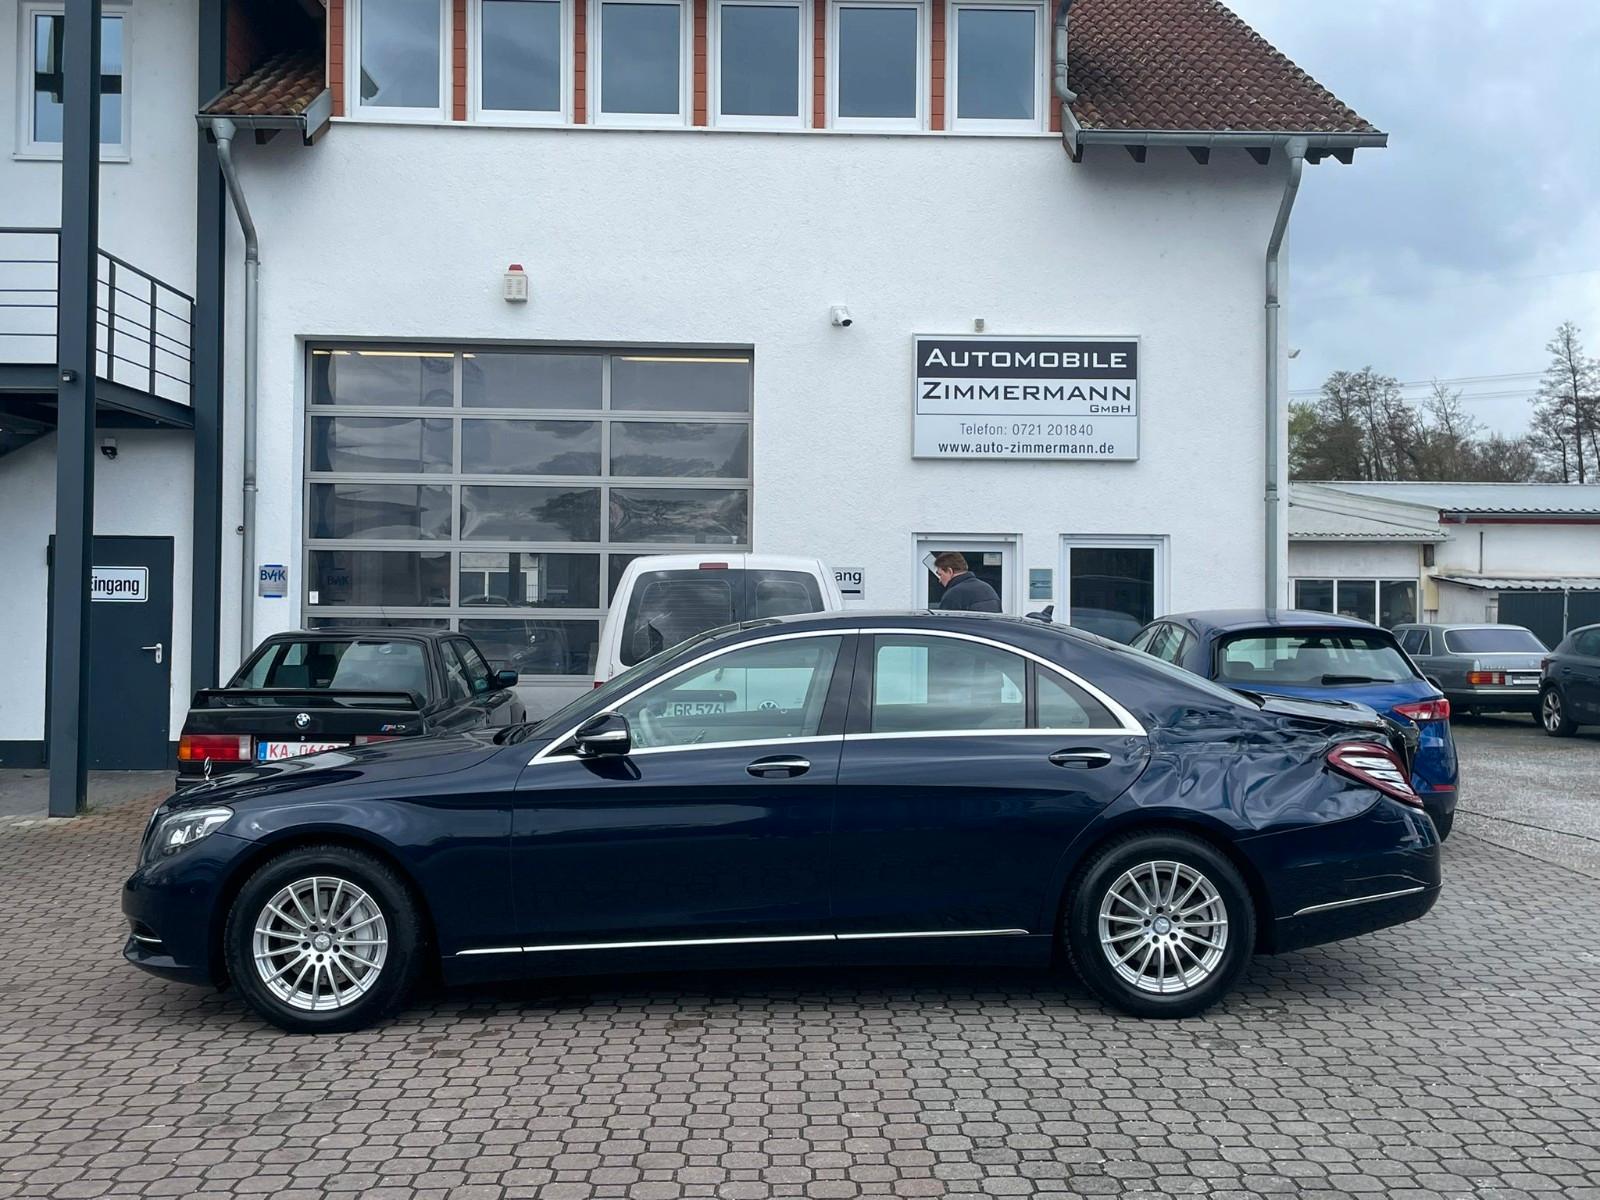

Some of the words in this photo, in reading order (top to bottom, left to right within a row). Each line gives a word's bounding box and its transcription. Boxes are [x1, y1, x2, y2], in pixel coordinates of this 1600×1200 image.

[924, 347, 1128, 369] AUTOMOBILE
[922, 381, 1131, 401] ZIMMERMANN
[959, 423, 1007, 436] Telefon:
[1012, 423, 1042, 436] 0721
[1047, 424, 1094, 436] 201840
[938, 441, 1115, 455] www.auto-zimmermann.de
[834, 571, 862, 585] ang
[269, 743, 288, 759] KA
